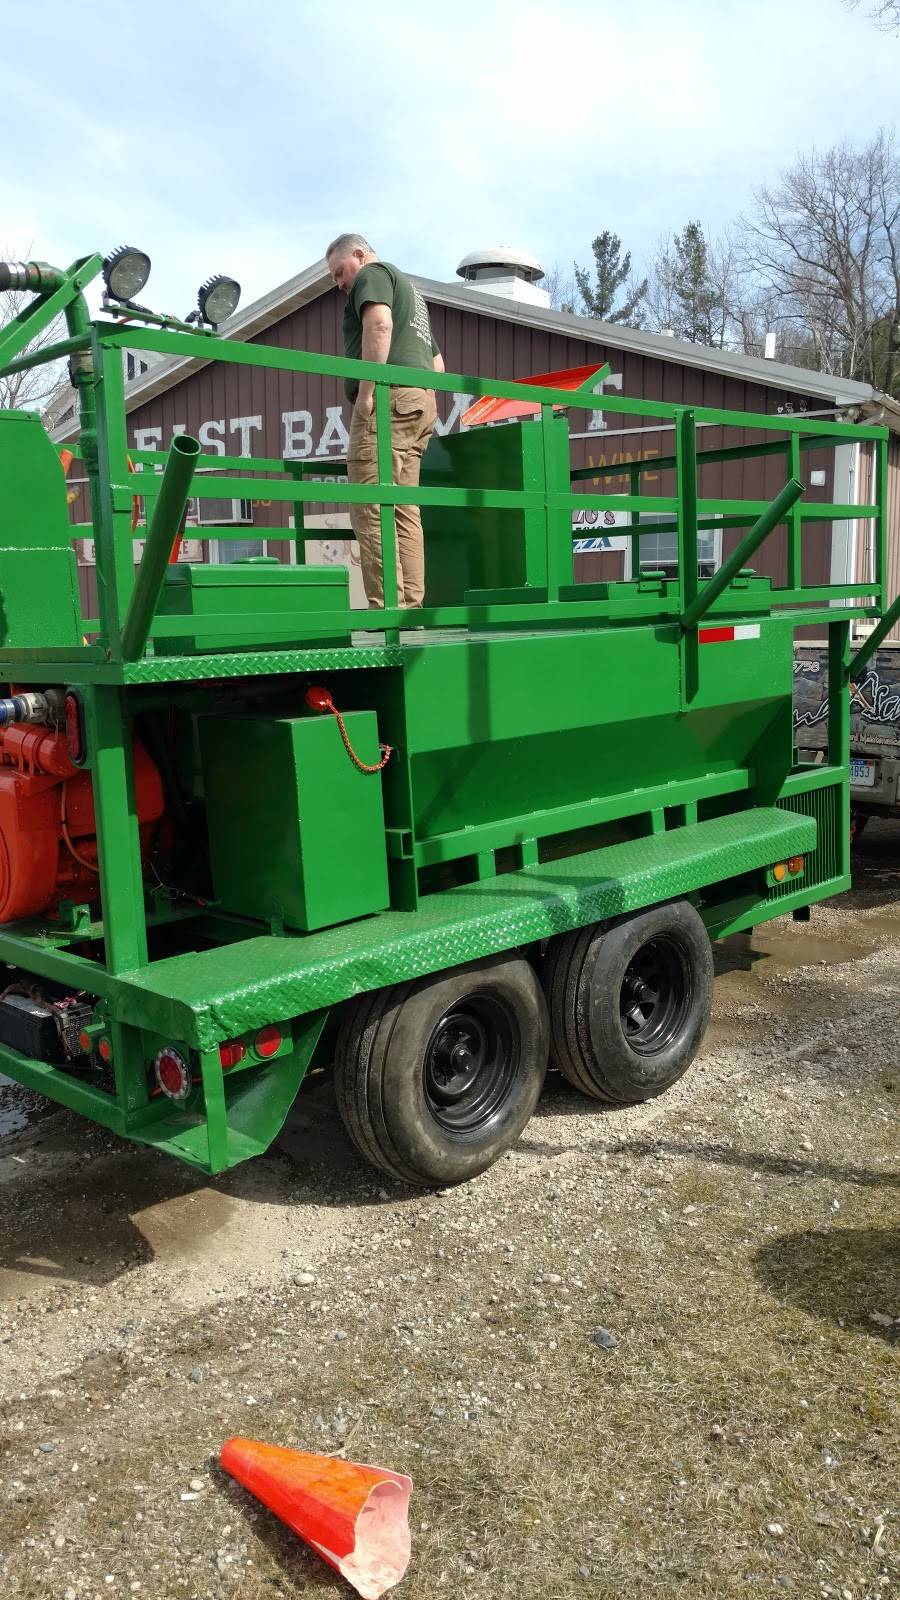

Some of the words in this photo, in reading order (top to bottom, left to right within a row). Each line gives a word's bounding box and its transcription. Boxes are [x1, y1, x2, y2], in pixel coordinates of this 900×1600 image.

[134, 415, 262, 472] EST
[281, 406, 350, 459] BA
[588, 449, 659, 486] WINE
